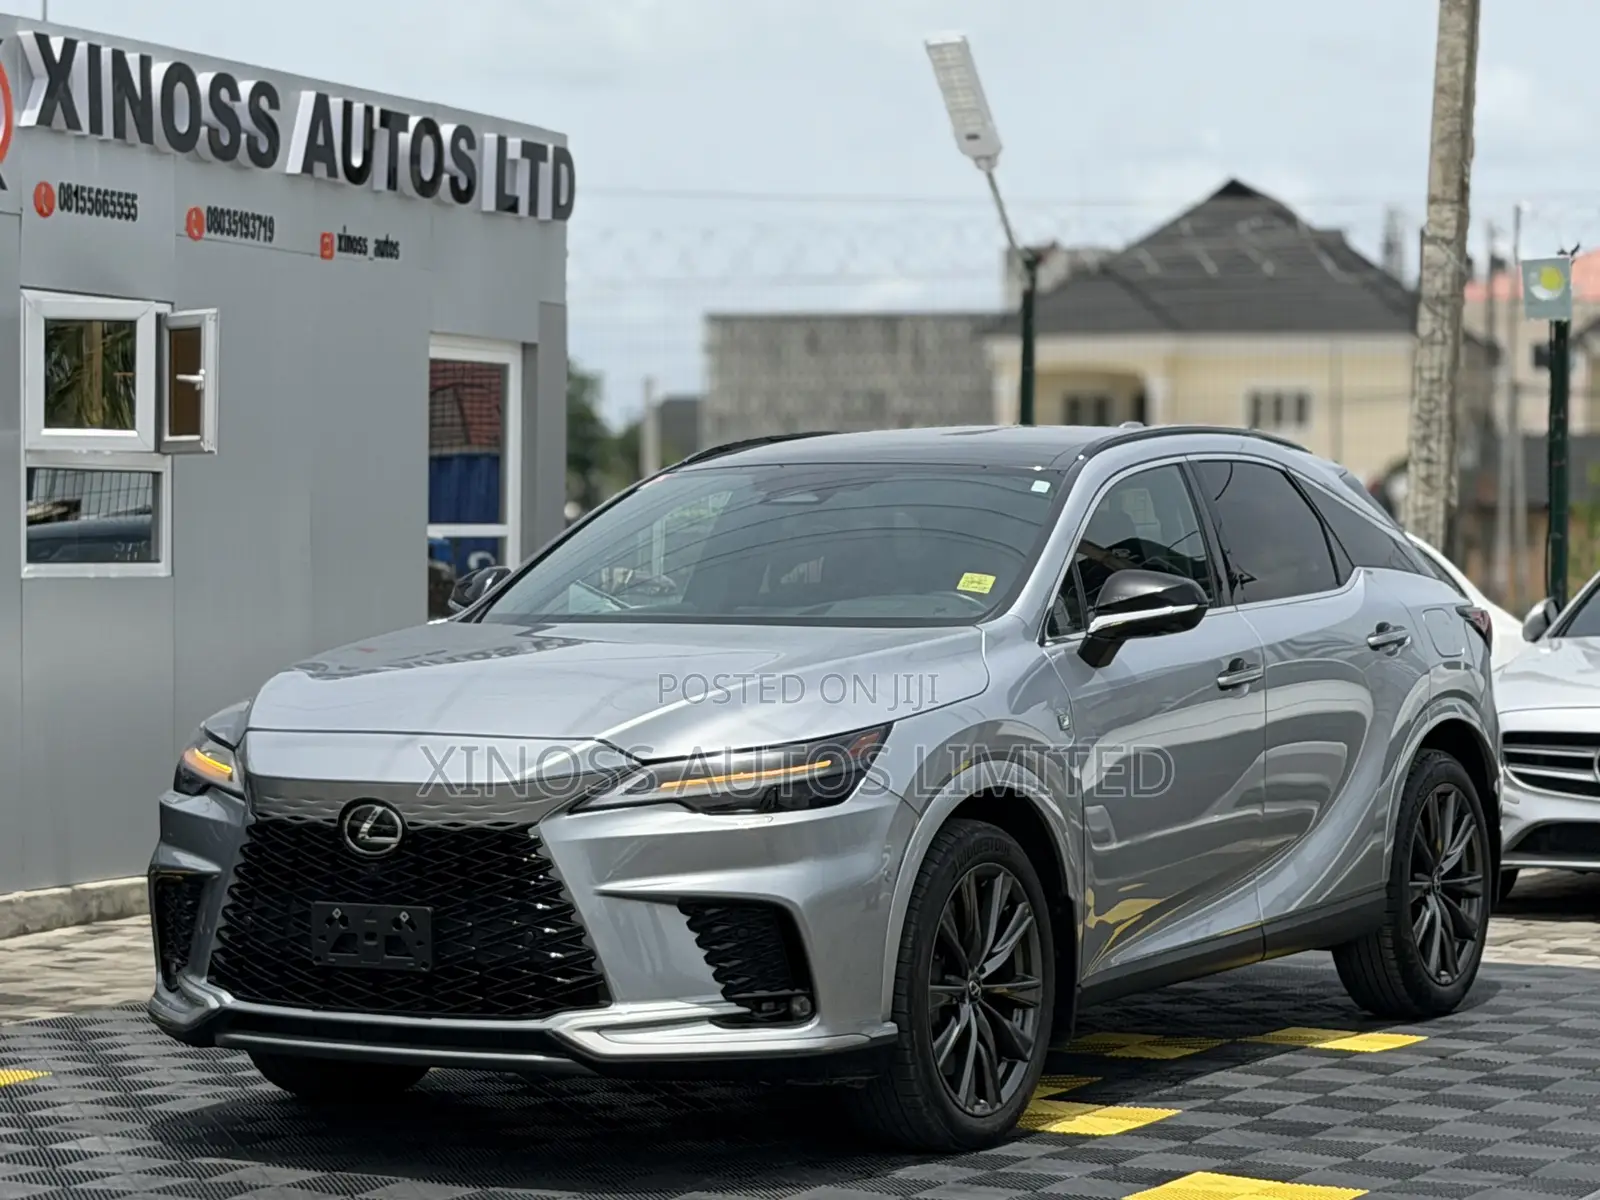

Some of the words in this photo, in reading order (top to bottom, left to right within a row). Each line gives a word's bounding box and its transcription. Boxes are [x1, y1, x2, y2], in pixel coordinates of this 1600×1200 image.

[18, 30, 280, 169] XINOSS
[286, 90, 477, 205] AUTOS
[481, 132, 576, 221] LTD
[58, 181, 138, 222] 08155665555
[206, 206, 275, 243] 08035193719
